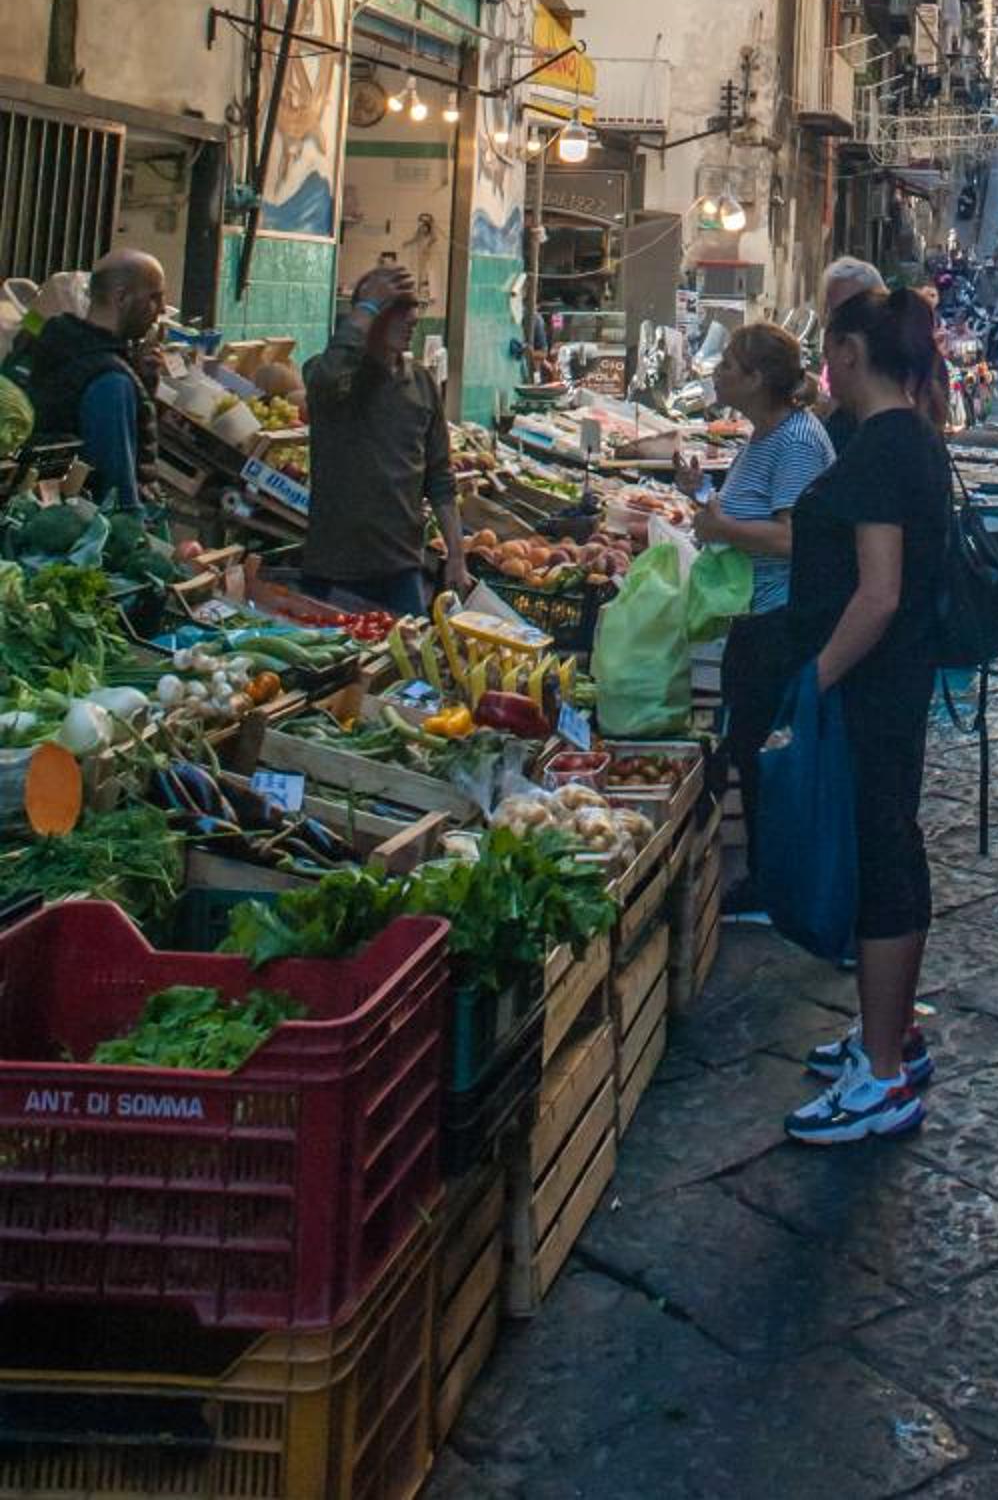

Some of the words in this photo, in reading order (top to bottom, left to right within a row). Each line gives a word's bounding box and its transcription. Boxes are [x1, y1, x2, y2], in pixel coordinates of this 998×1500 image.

[24, 1090, 79, 1115] ANT.
[86, 1092, 109, 1115] DI
[117, 1093, 204, 1119] SOMMA
